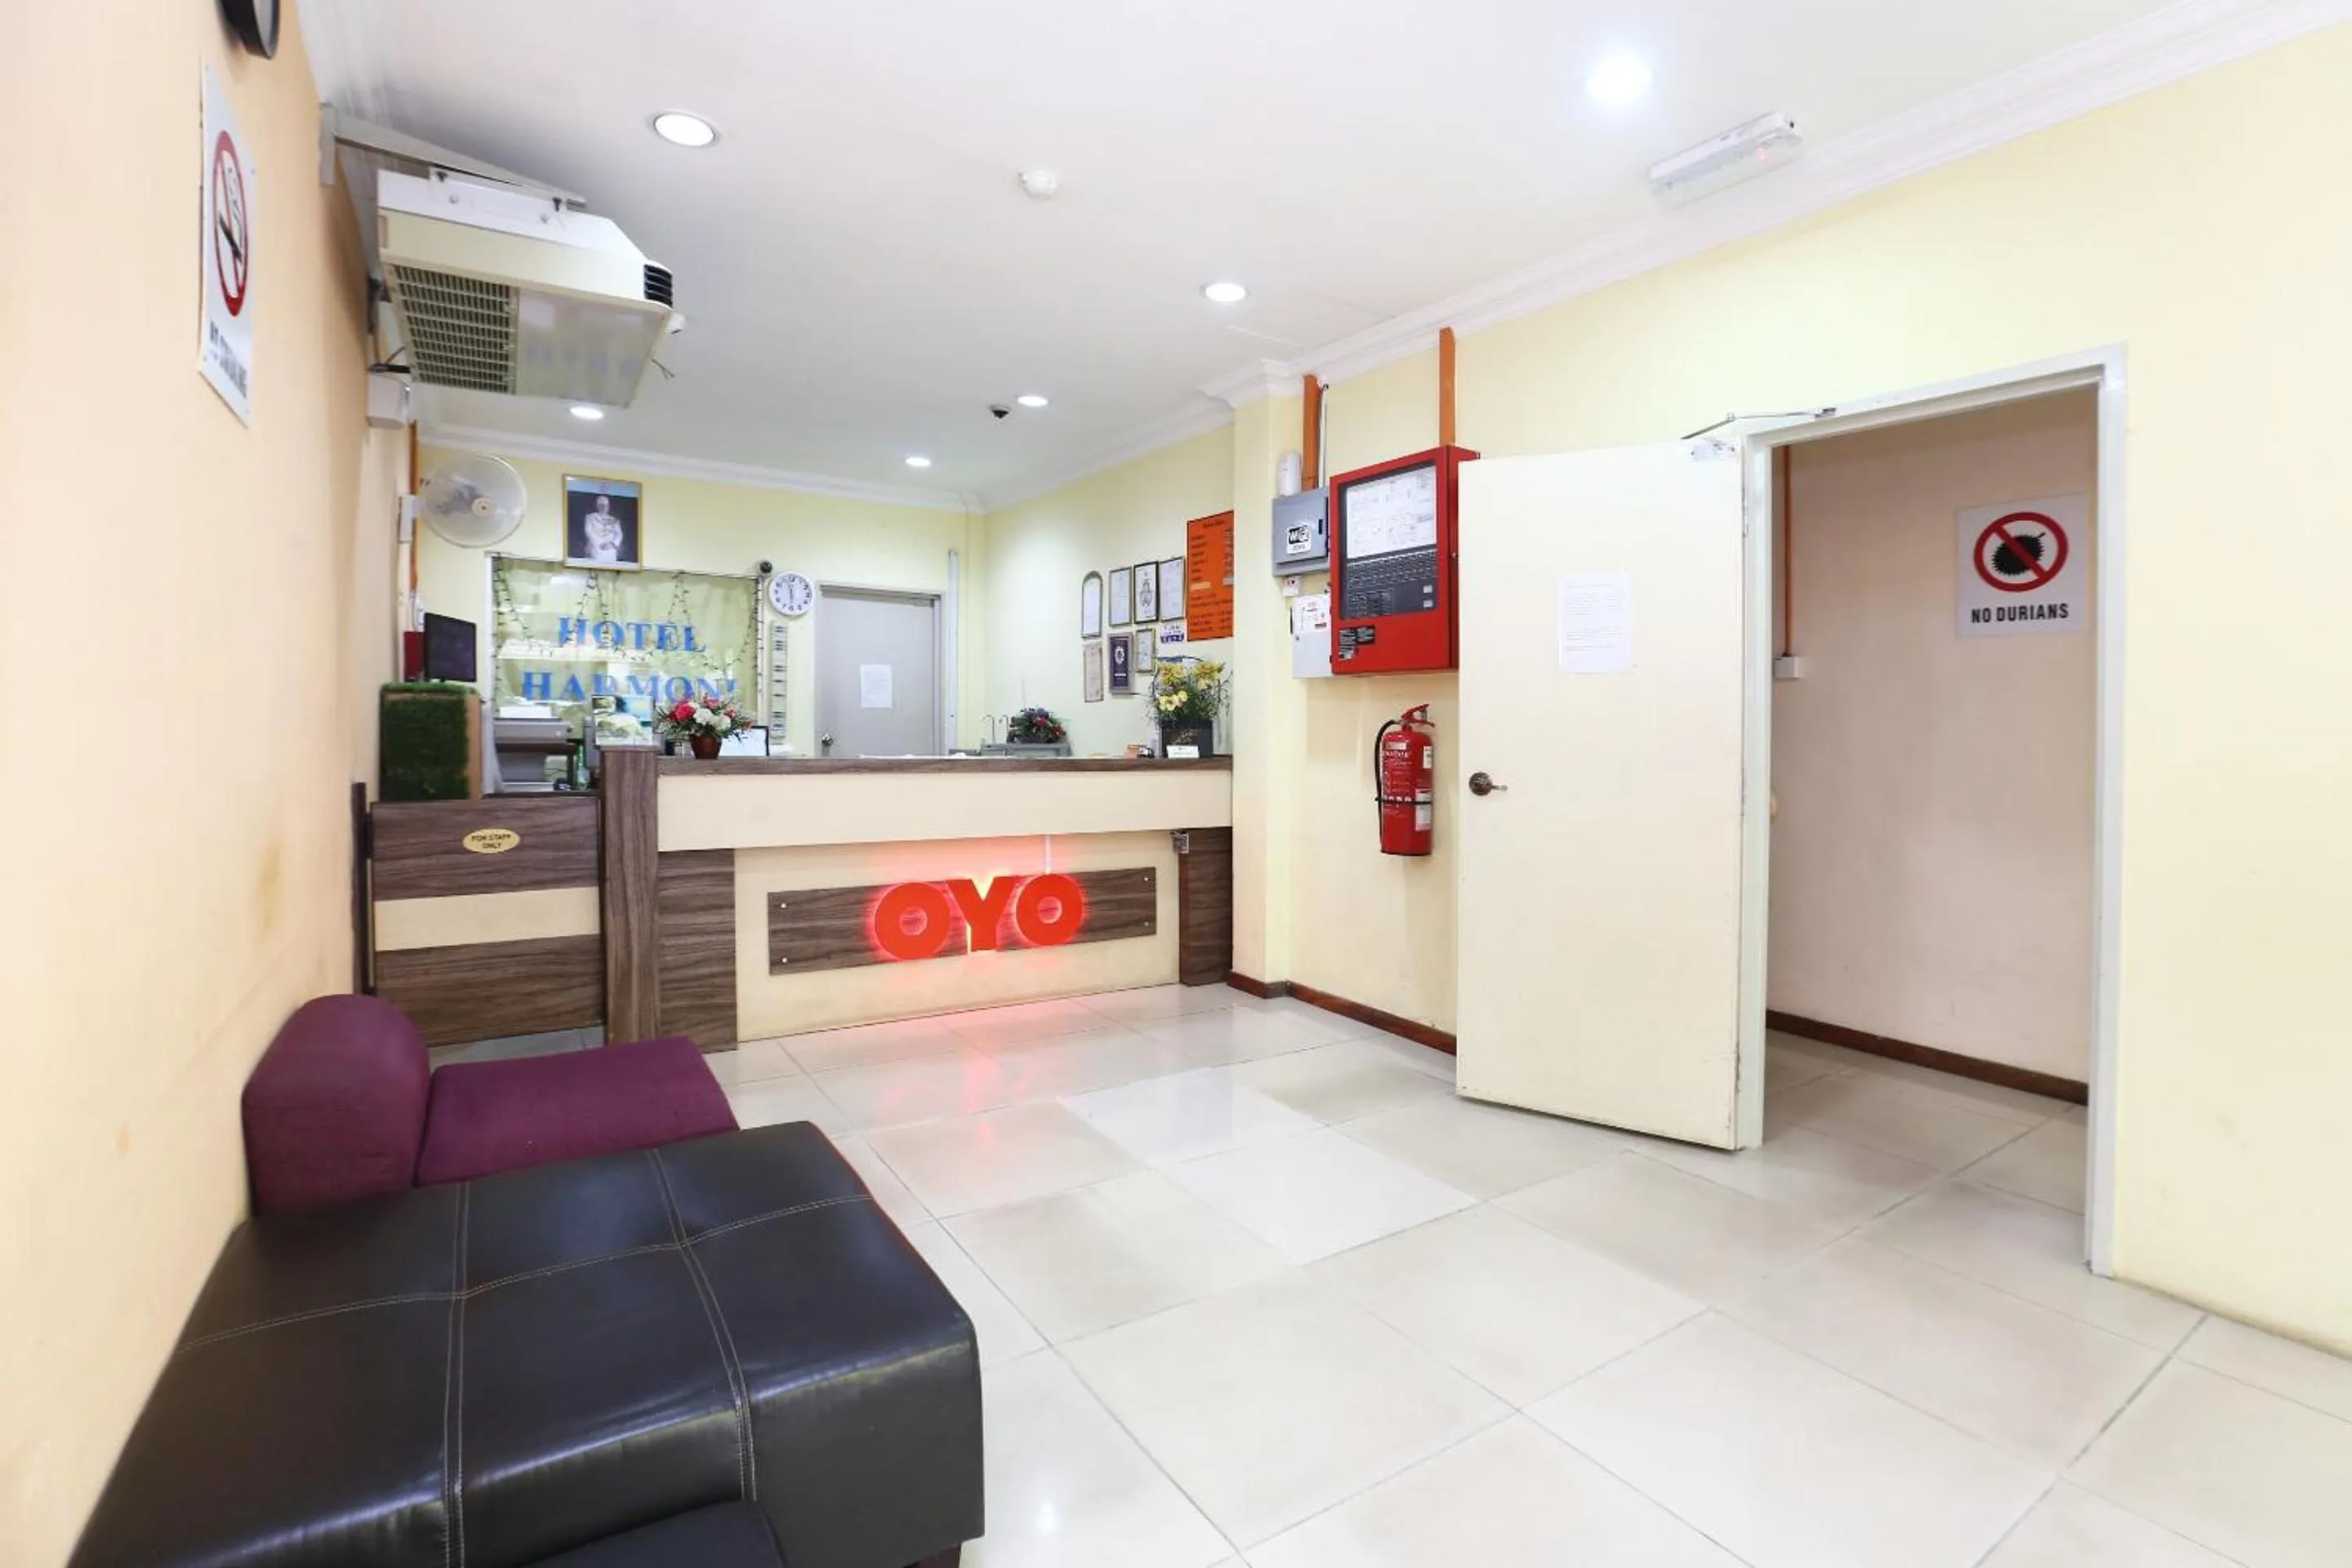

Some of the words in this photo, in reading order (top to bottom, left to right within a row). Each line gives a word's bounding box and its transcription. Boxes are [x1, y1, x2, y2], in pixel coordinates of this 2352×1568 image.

[1971, 608, 1991, 623] NO
[1996, 603, 2069, 621] DURIANS
[559, 617, 706, 653] HOTEL
[875, 873, 1085, 960] OYO
